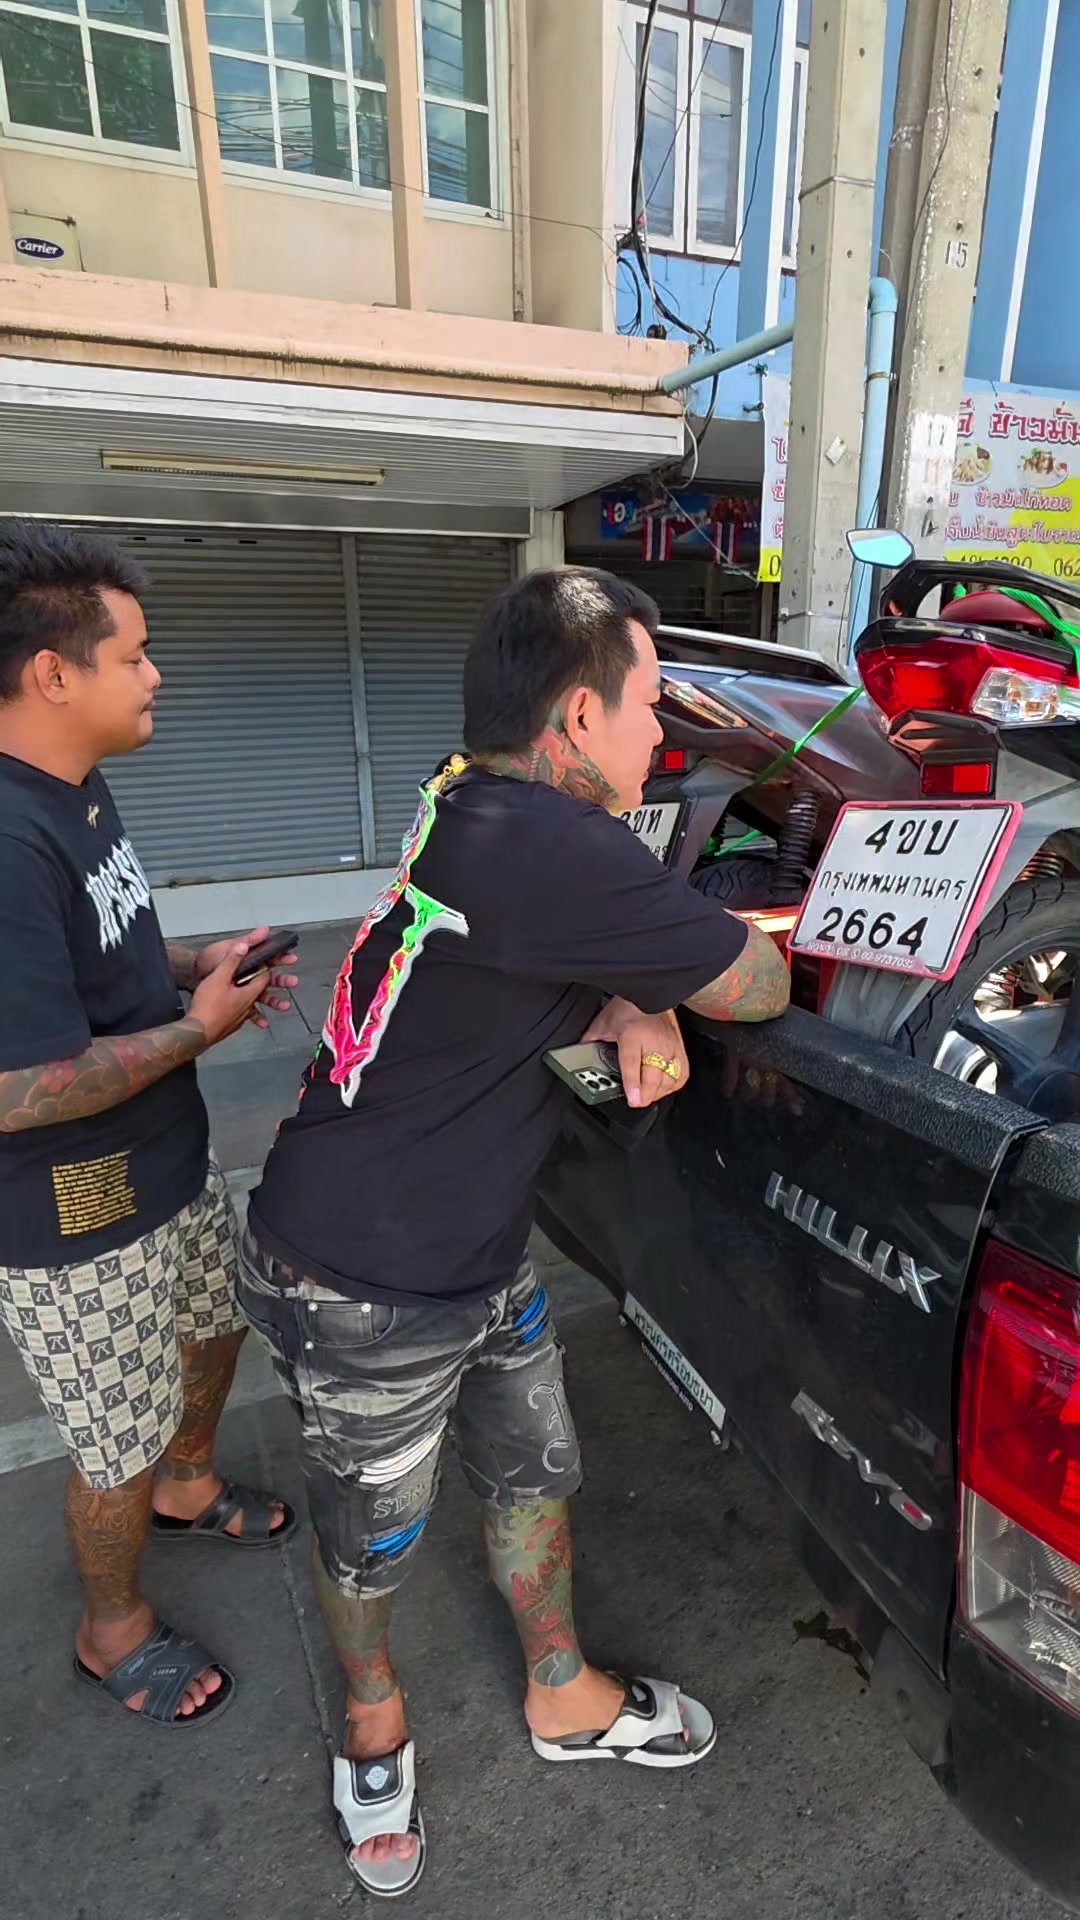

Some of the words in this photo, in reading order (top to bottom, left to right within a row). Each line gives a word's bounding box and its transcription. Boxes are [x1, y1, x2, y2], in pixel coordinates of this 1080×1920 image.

[17, 240, 59, 255] Carrier
[945, 241, 969, 268] 15
[865, 819, 959, 855] 4ขบ
[819, 870, 968, 900] กรุงเทพมหานคร
[816, 906, 928, 956] 2664
[764, 1170, 942, 1313] HILUX
